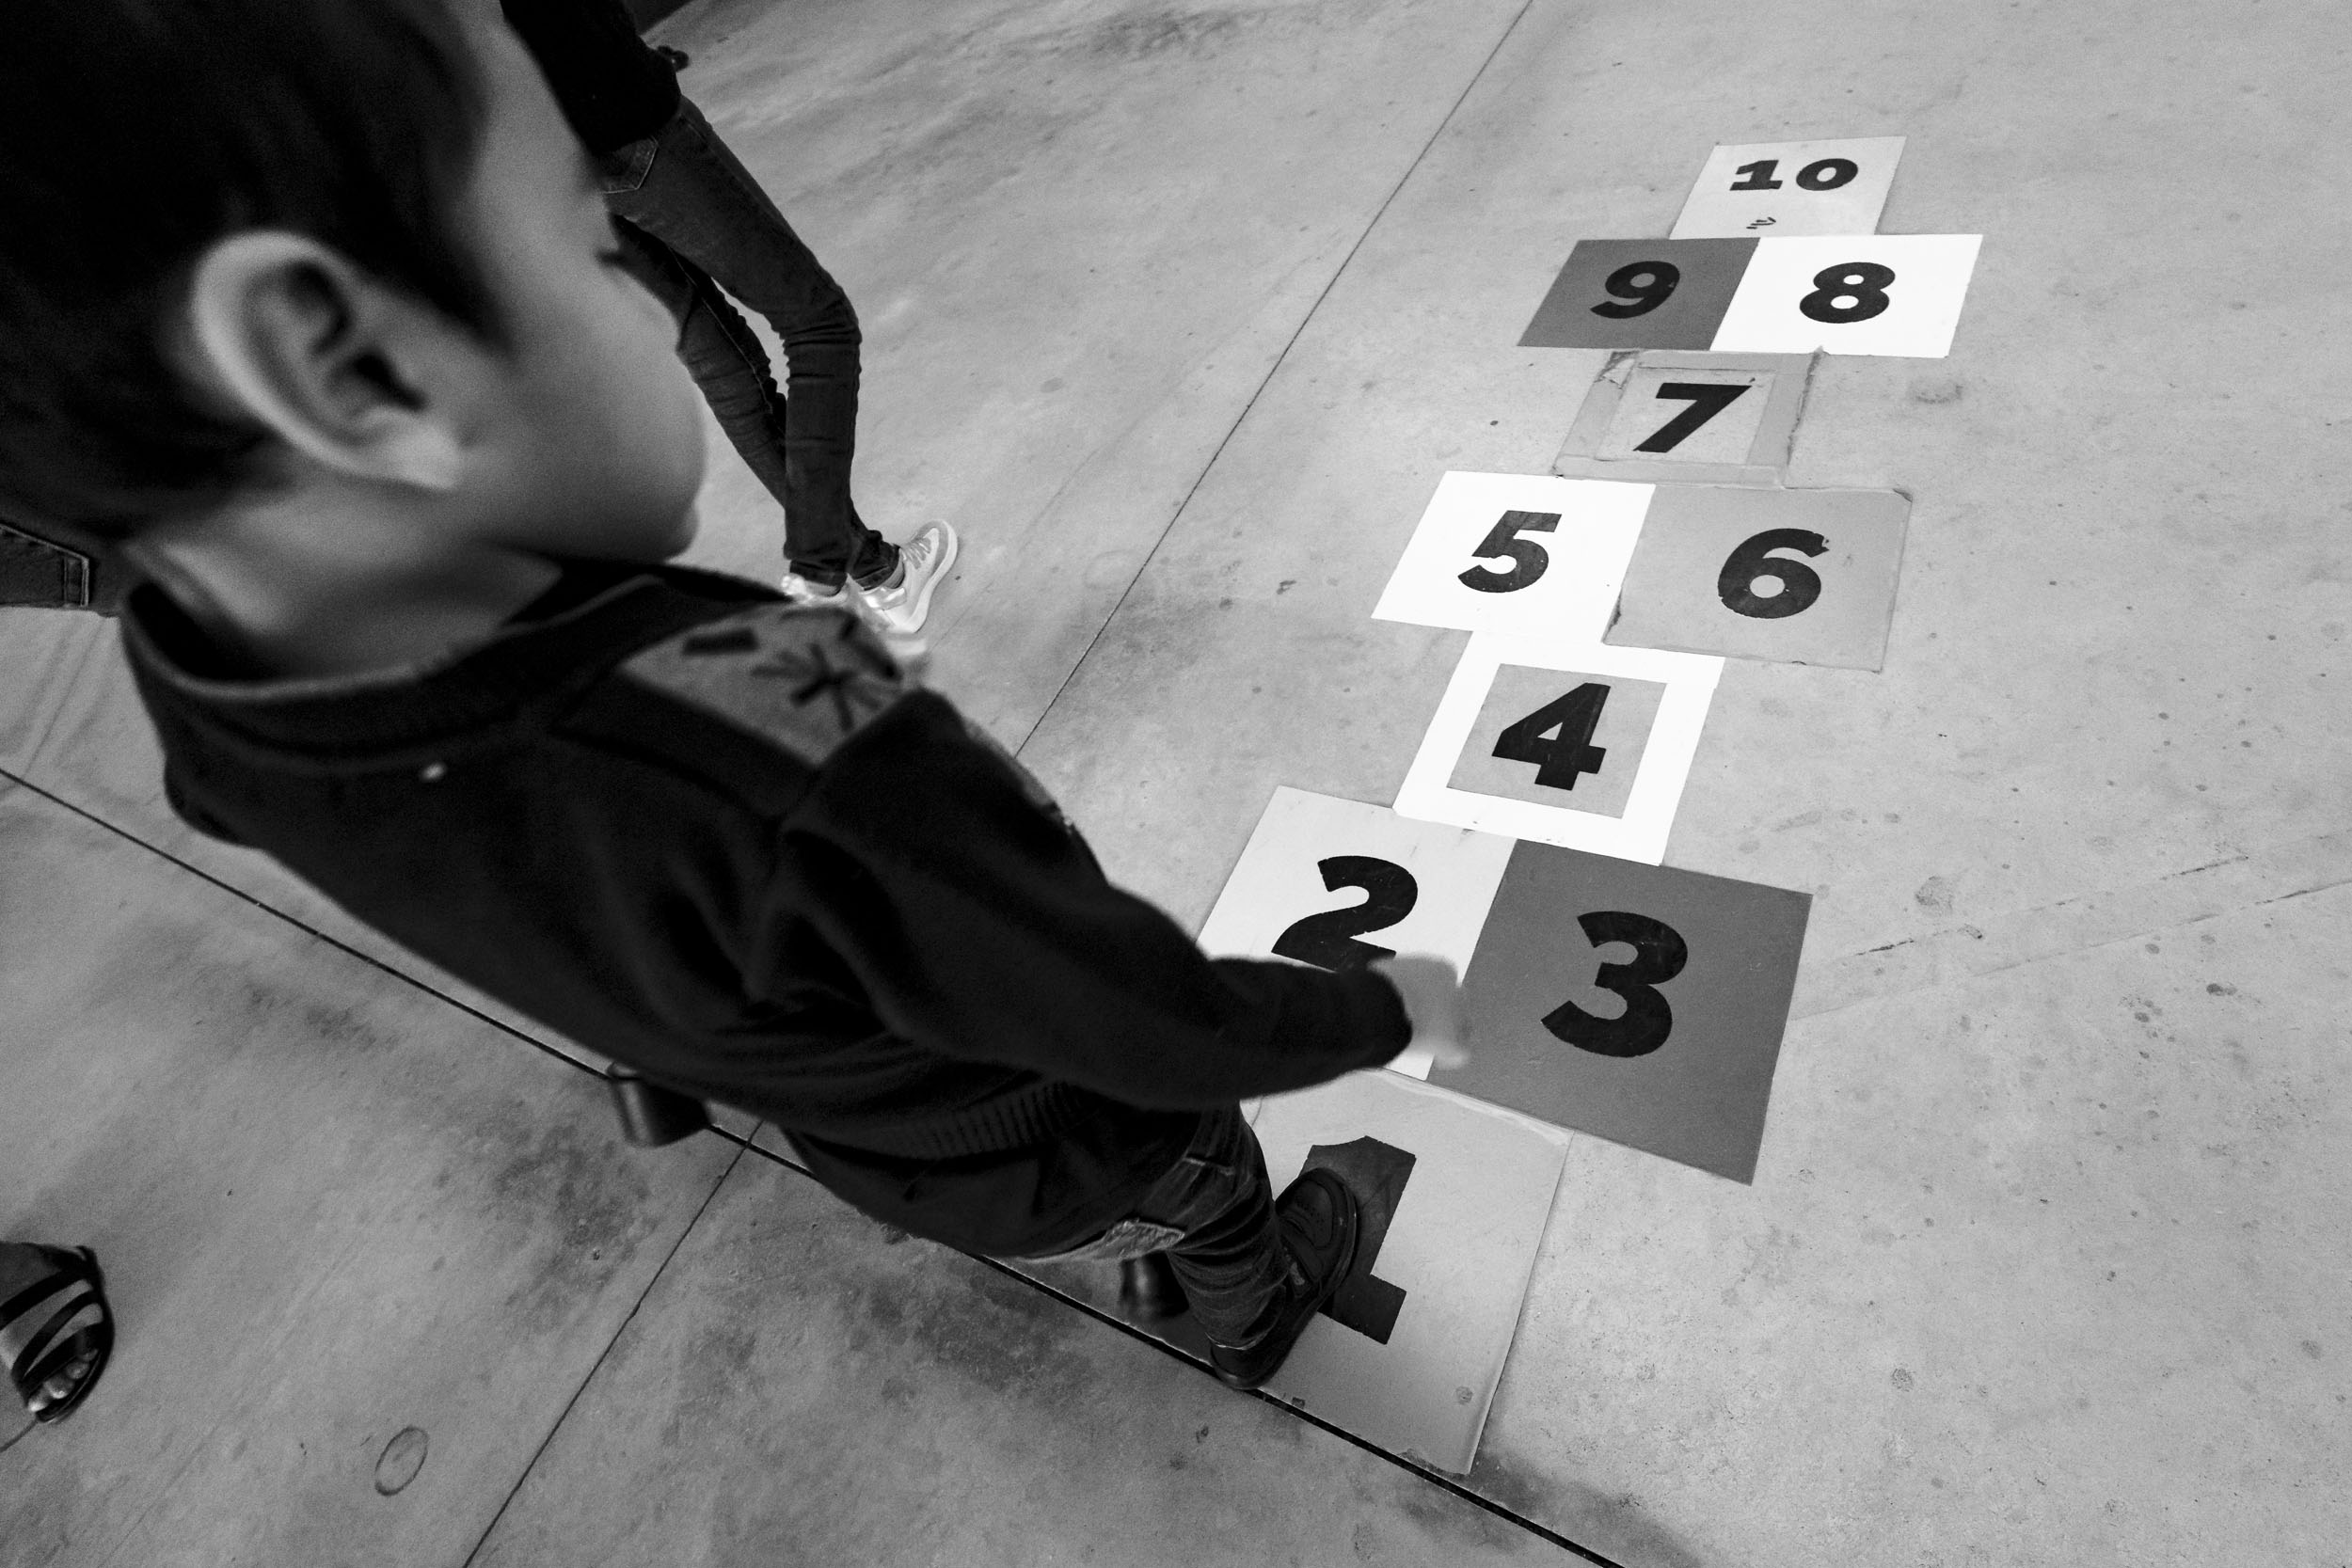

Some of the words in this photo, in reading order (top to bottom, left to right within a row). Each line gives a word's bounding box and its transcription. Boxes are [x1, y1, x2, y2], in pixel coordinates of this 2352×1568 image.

[1729, 158, 1859, 191] 10
[1590, 261, 1680, 319] 9
[1799, 261, 1896, 324] 8
[1632, 382, 1752, 452] 7
[1457, 510, 1562, 594] 5
[1718, 528, 1830, 619] 6
[1492, 682, 1612, 791] 4
[1272, 855, 1419, 973] 2
[1541, 911, 1689, 1058] 3
